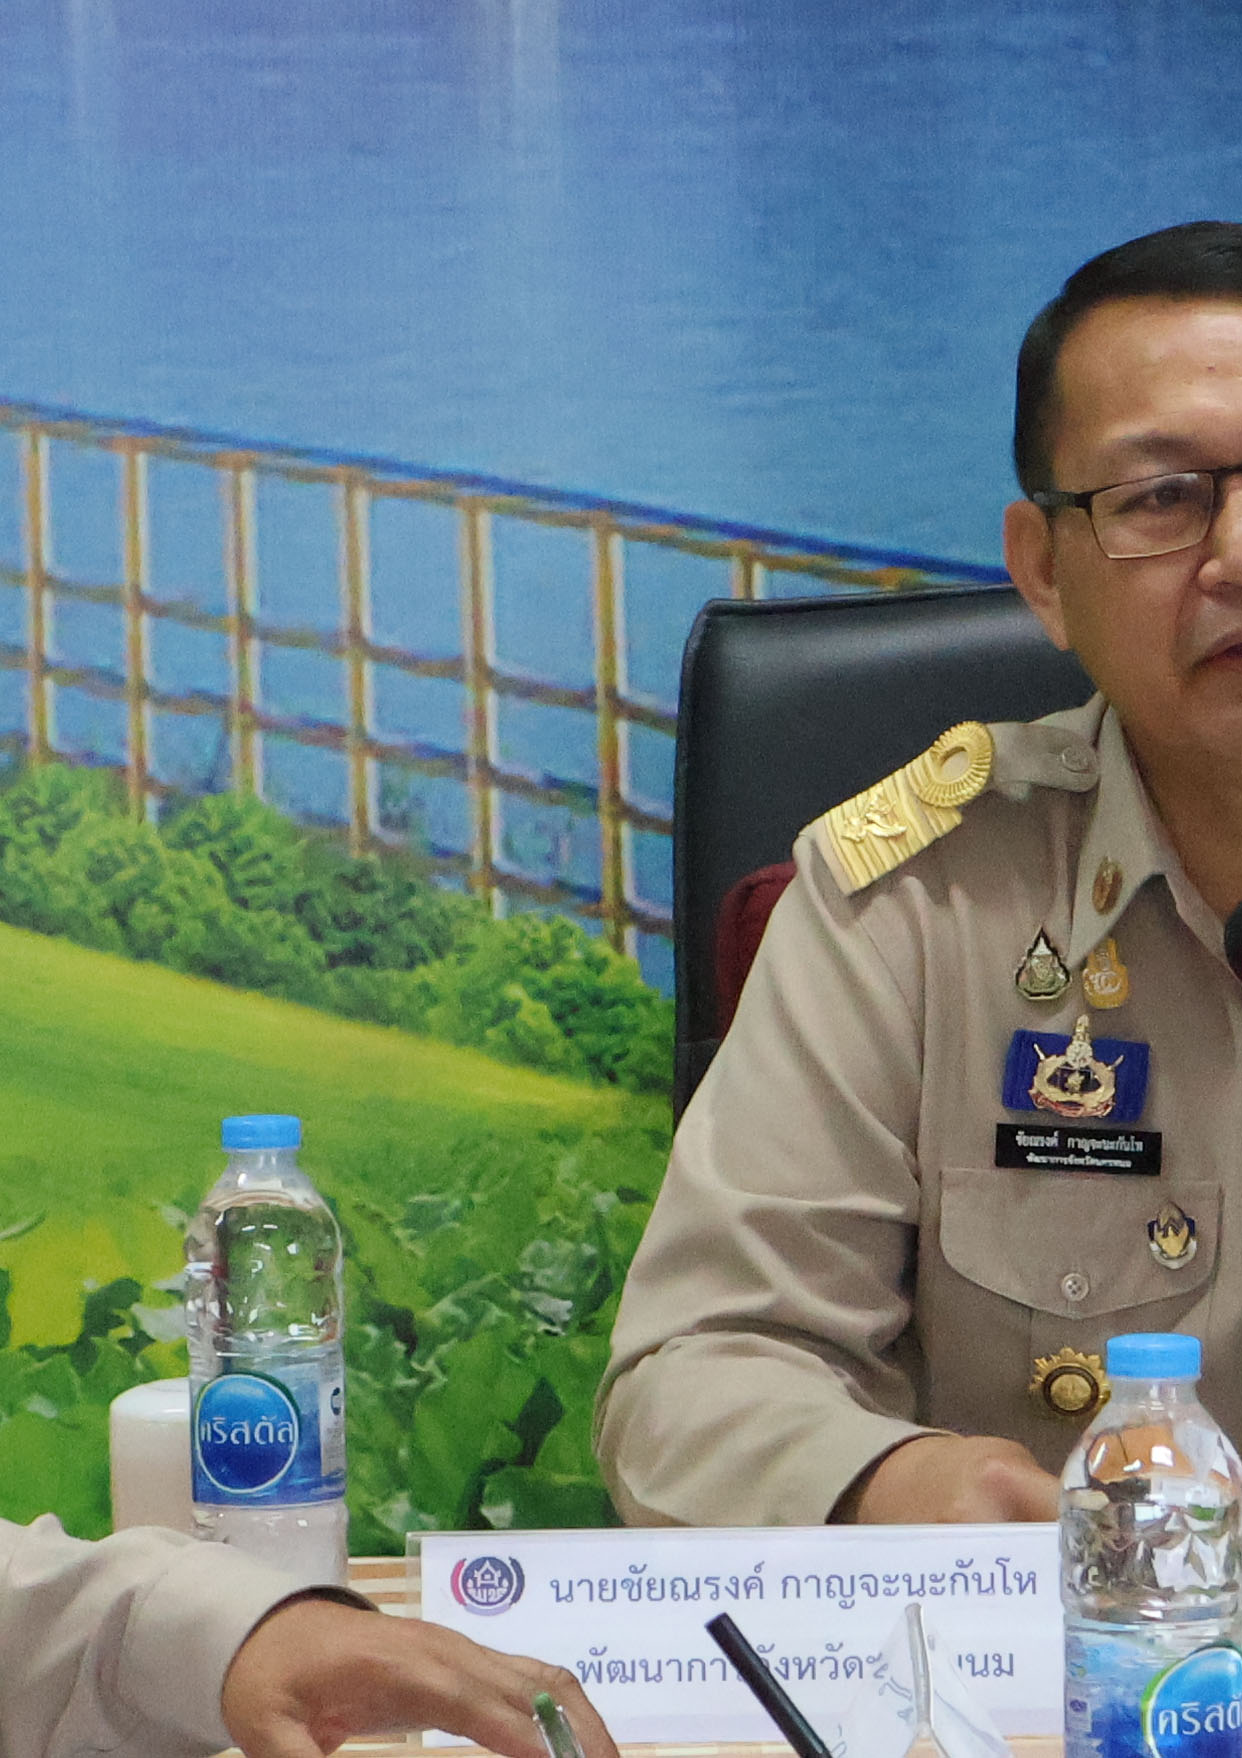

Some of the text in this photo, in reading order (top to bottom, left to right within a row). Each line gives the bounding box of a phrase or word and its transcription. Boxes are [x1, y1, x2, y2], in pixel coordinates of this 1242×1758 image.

[550, 1557, 1037, 1610] นายชัยณรงค์ กาญจะนะกันโห
